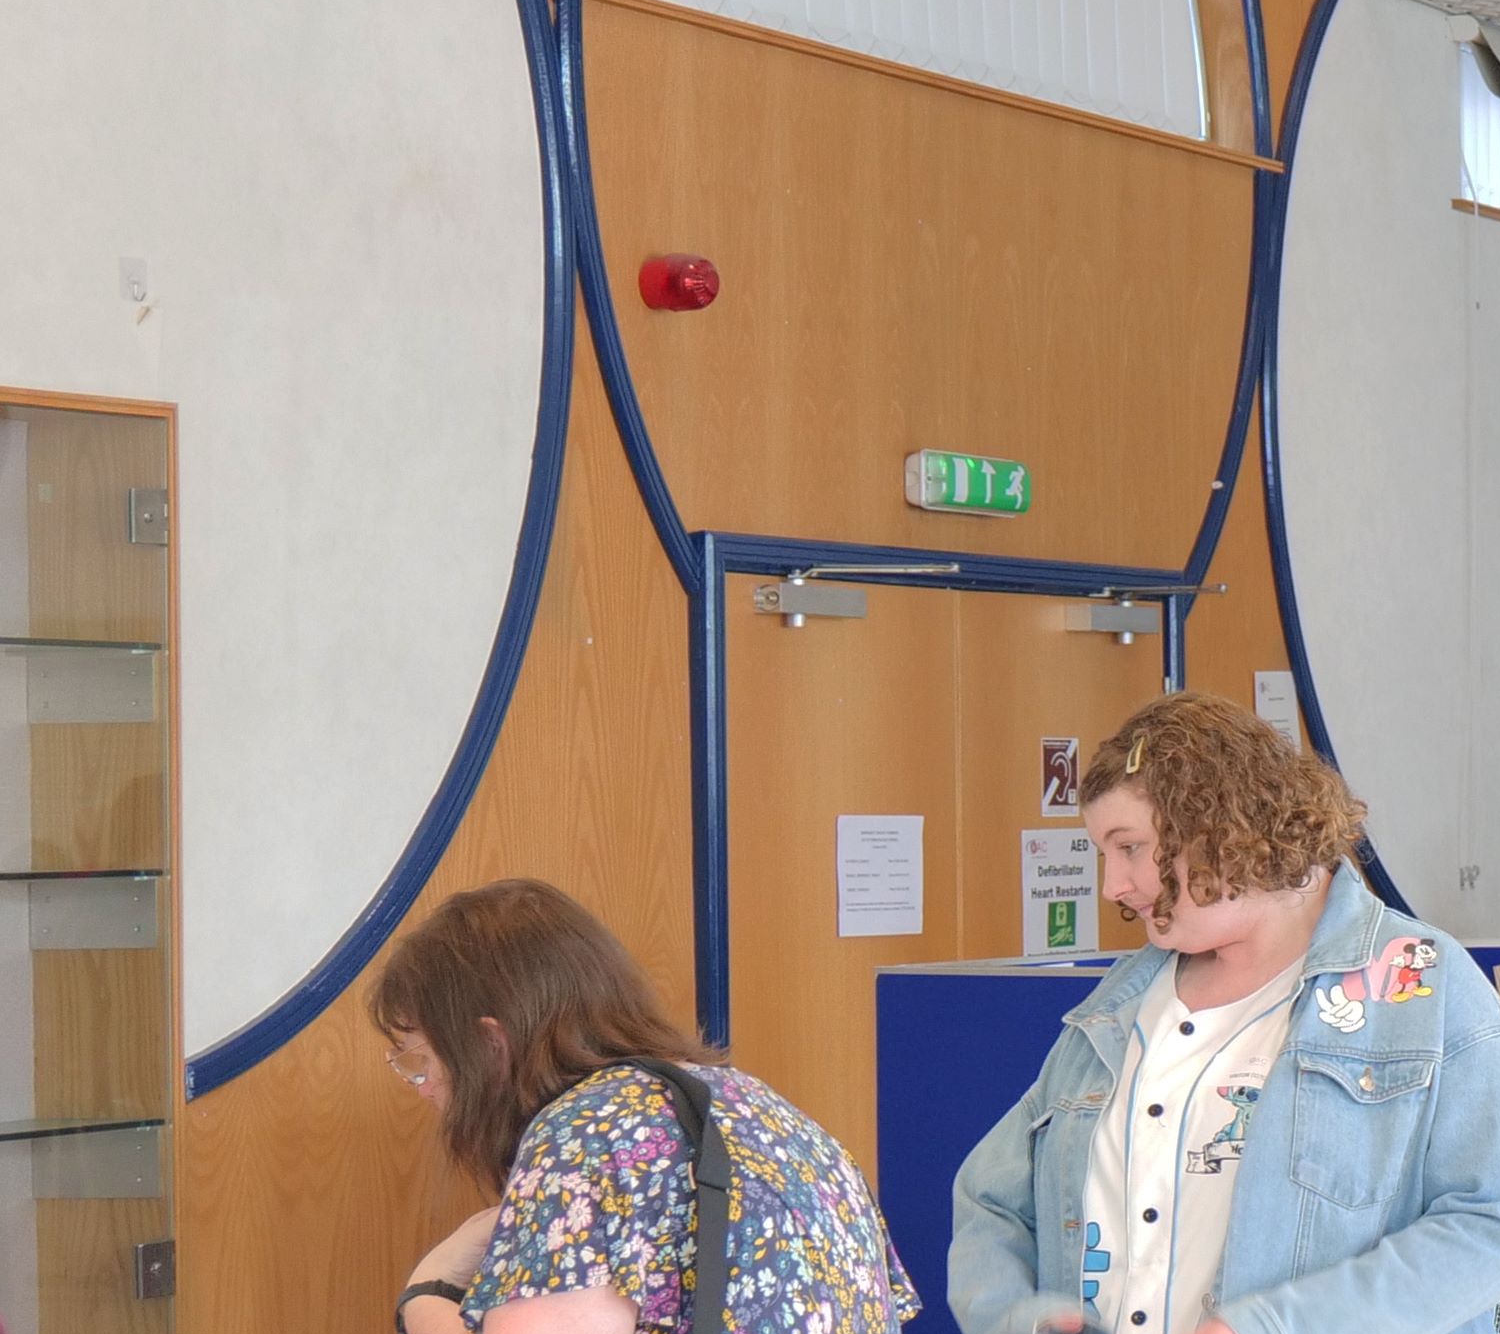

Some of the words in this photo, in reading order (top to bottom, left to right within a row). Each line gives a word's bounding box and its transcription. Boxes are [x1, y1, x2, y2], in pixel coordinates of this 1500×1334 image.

[1071, 838, 1089, 852] AED
[1038, 865, 1085, 878] Defibrillator
[1031, 887, 1053, 899] Heart
[1056, 885, 1092, 898] Restarter
